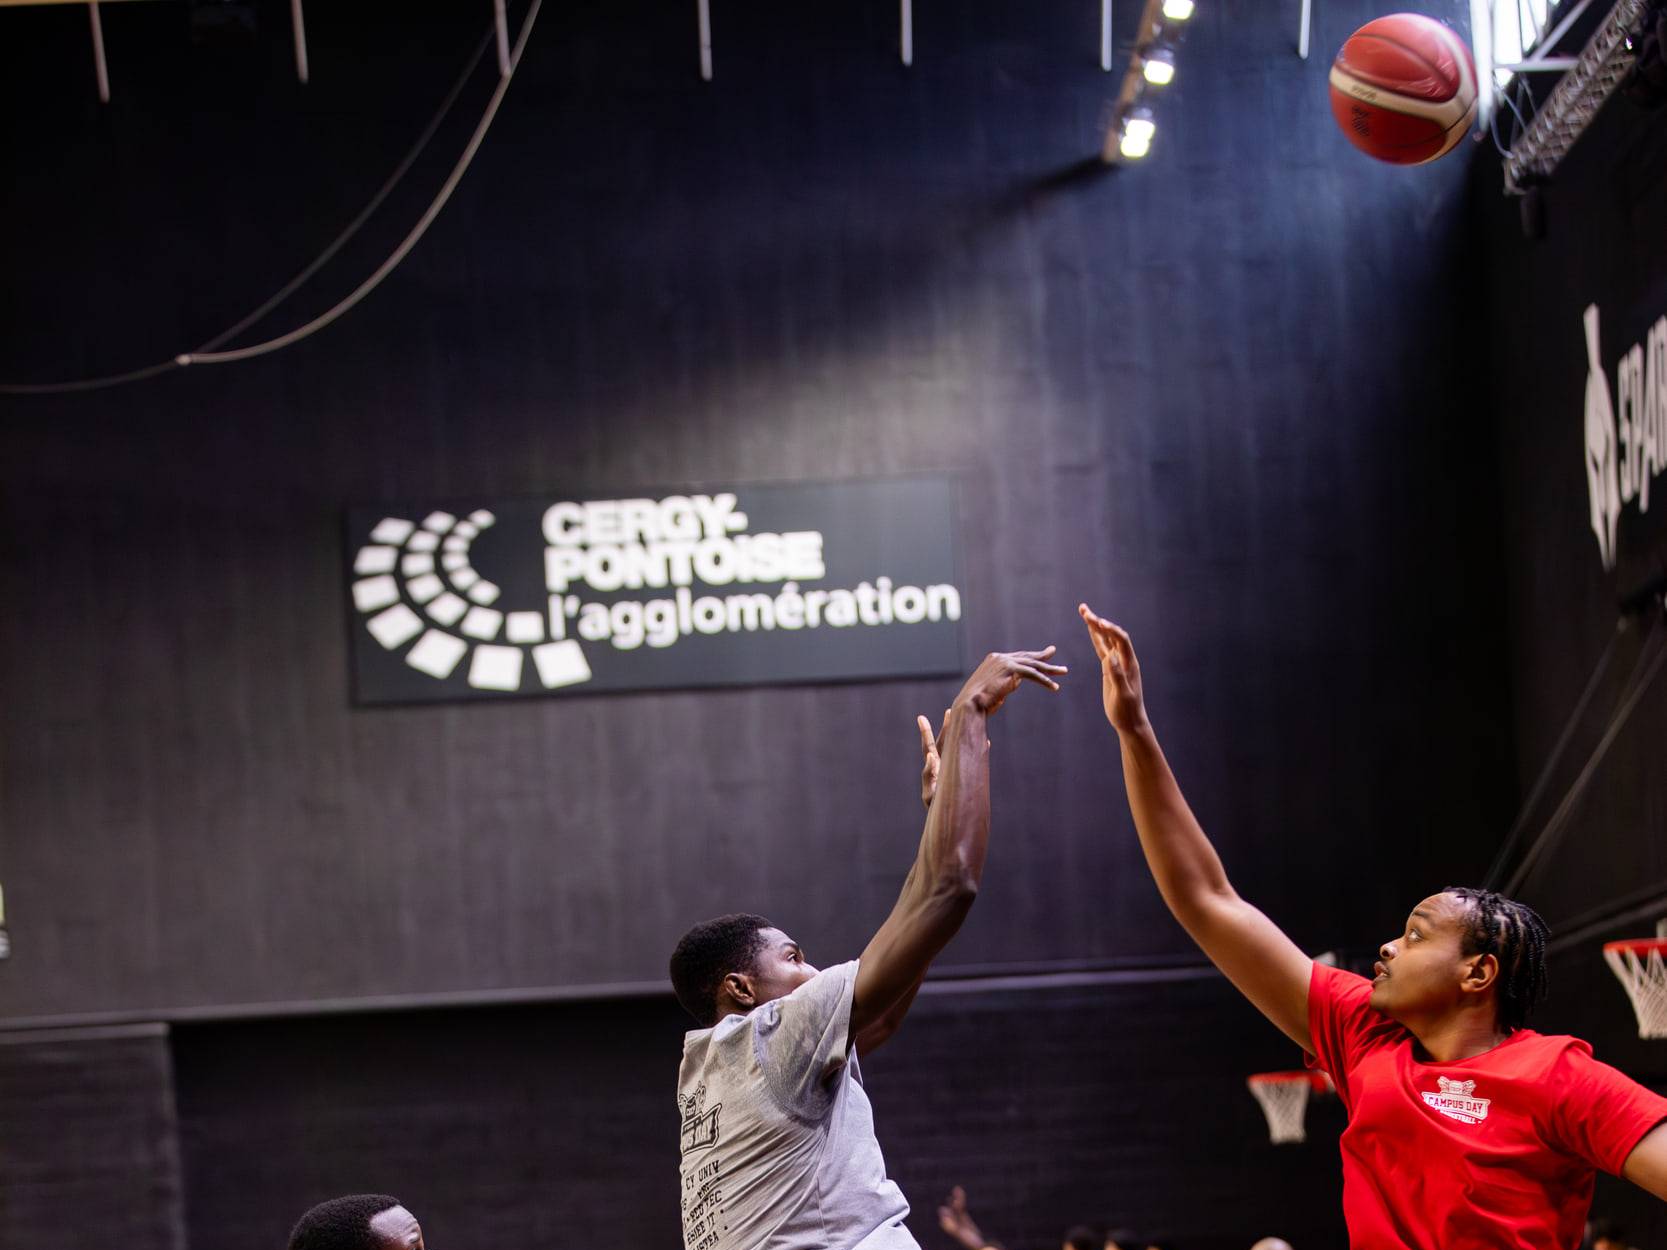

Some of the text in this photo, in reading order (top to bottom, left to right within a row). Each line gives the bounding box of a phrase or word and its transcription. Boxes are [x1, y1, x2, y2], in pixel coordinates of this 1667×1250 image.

[542, 493, 748, 545] CERGY-
[544, 531, 825, 592] PONTOISE
[548, 576, 961, 650] l'agglomération
[1428, 1096, 1483, 1114] CAMPUS DAY
